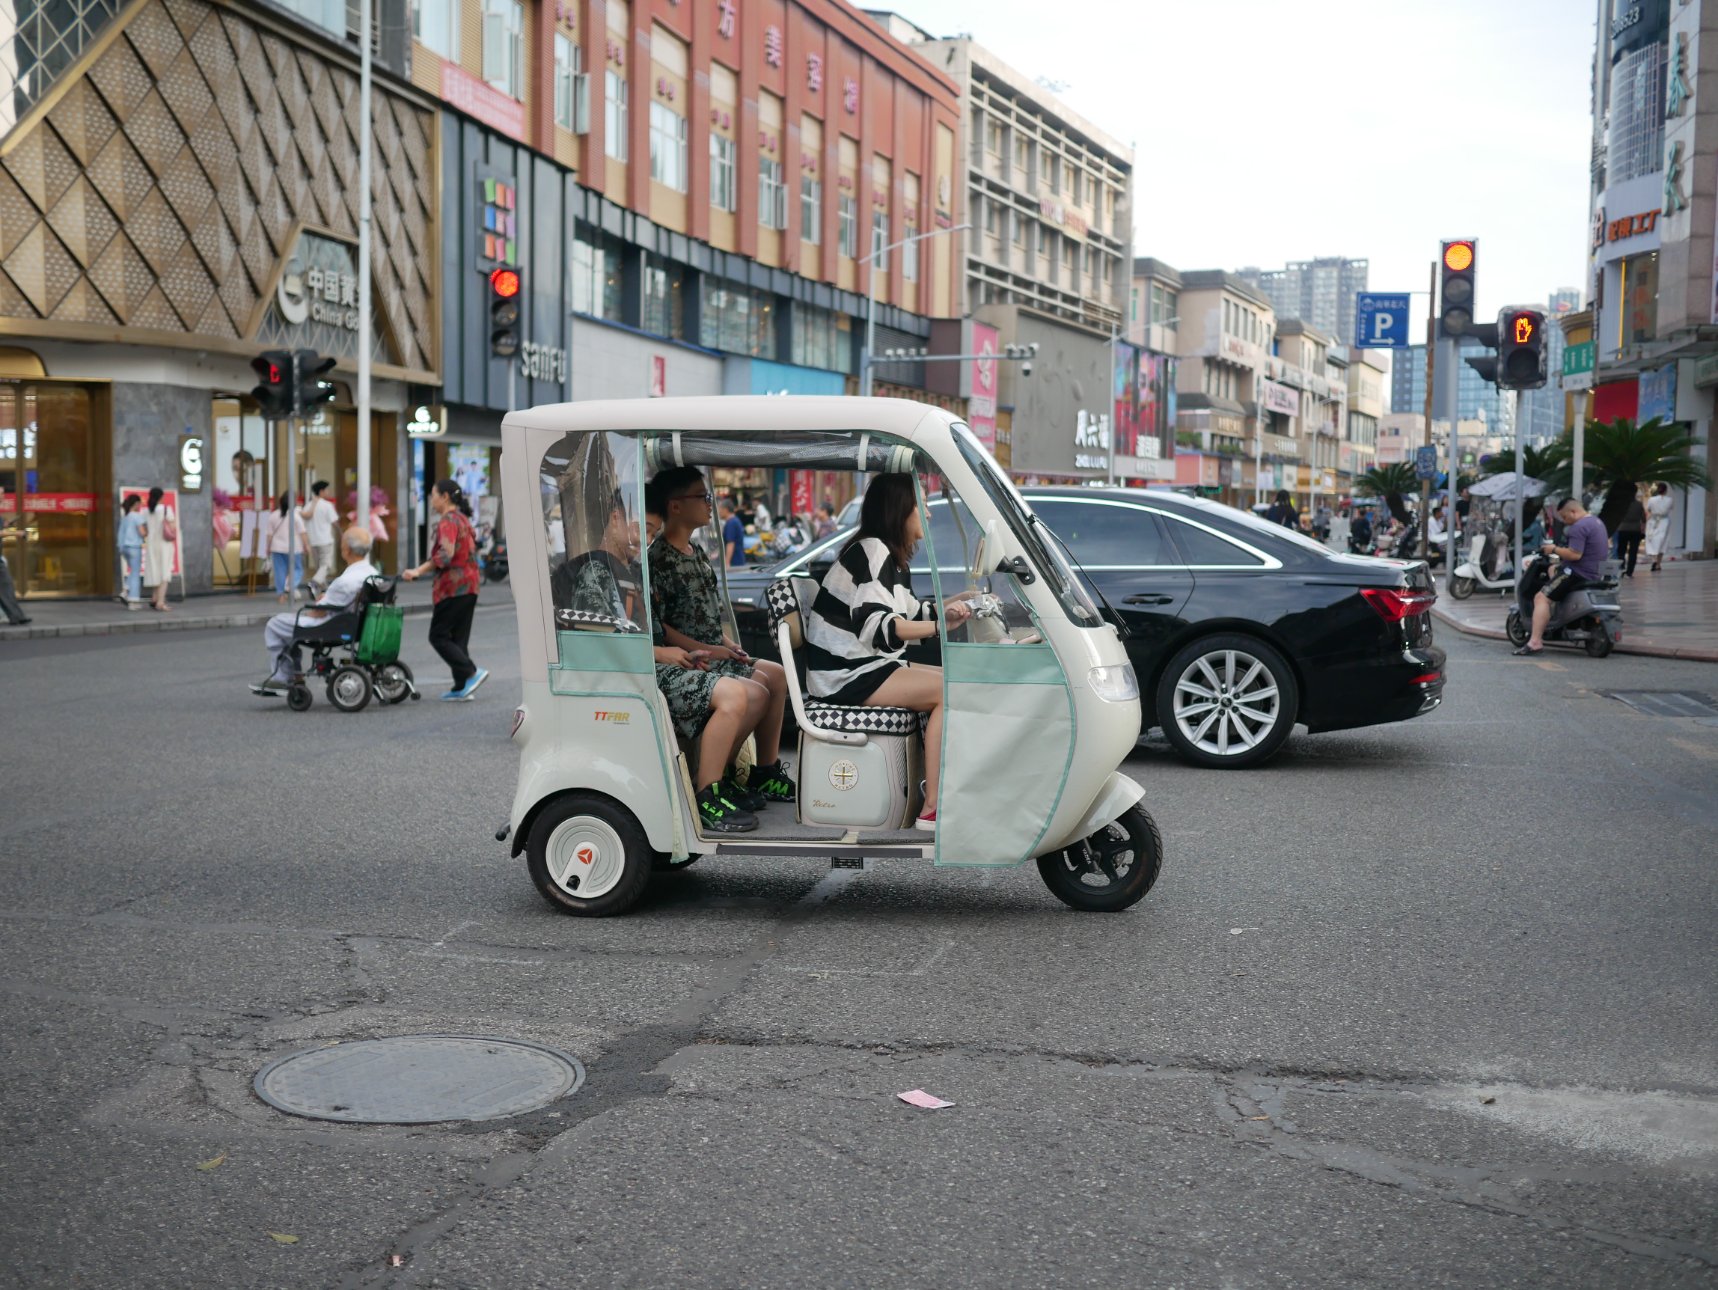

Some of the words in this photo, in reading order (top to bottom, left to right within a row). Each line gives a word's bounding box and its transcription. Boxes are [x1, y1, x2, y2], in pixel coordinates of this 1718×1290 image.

[308, 266, 360, 307] 中国黄
[312, 302, 342, 326] China
[1375, 312, 1394, 339] P
[594, 711, 630, 721] TTFAR
